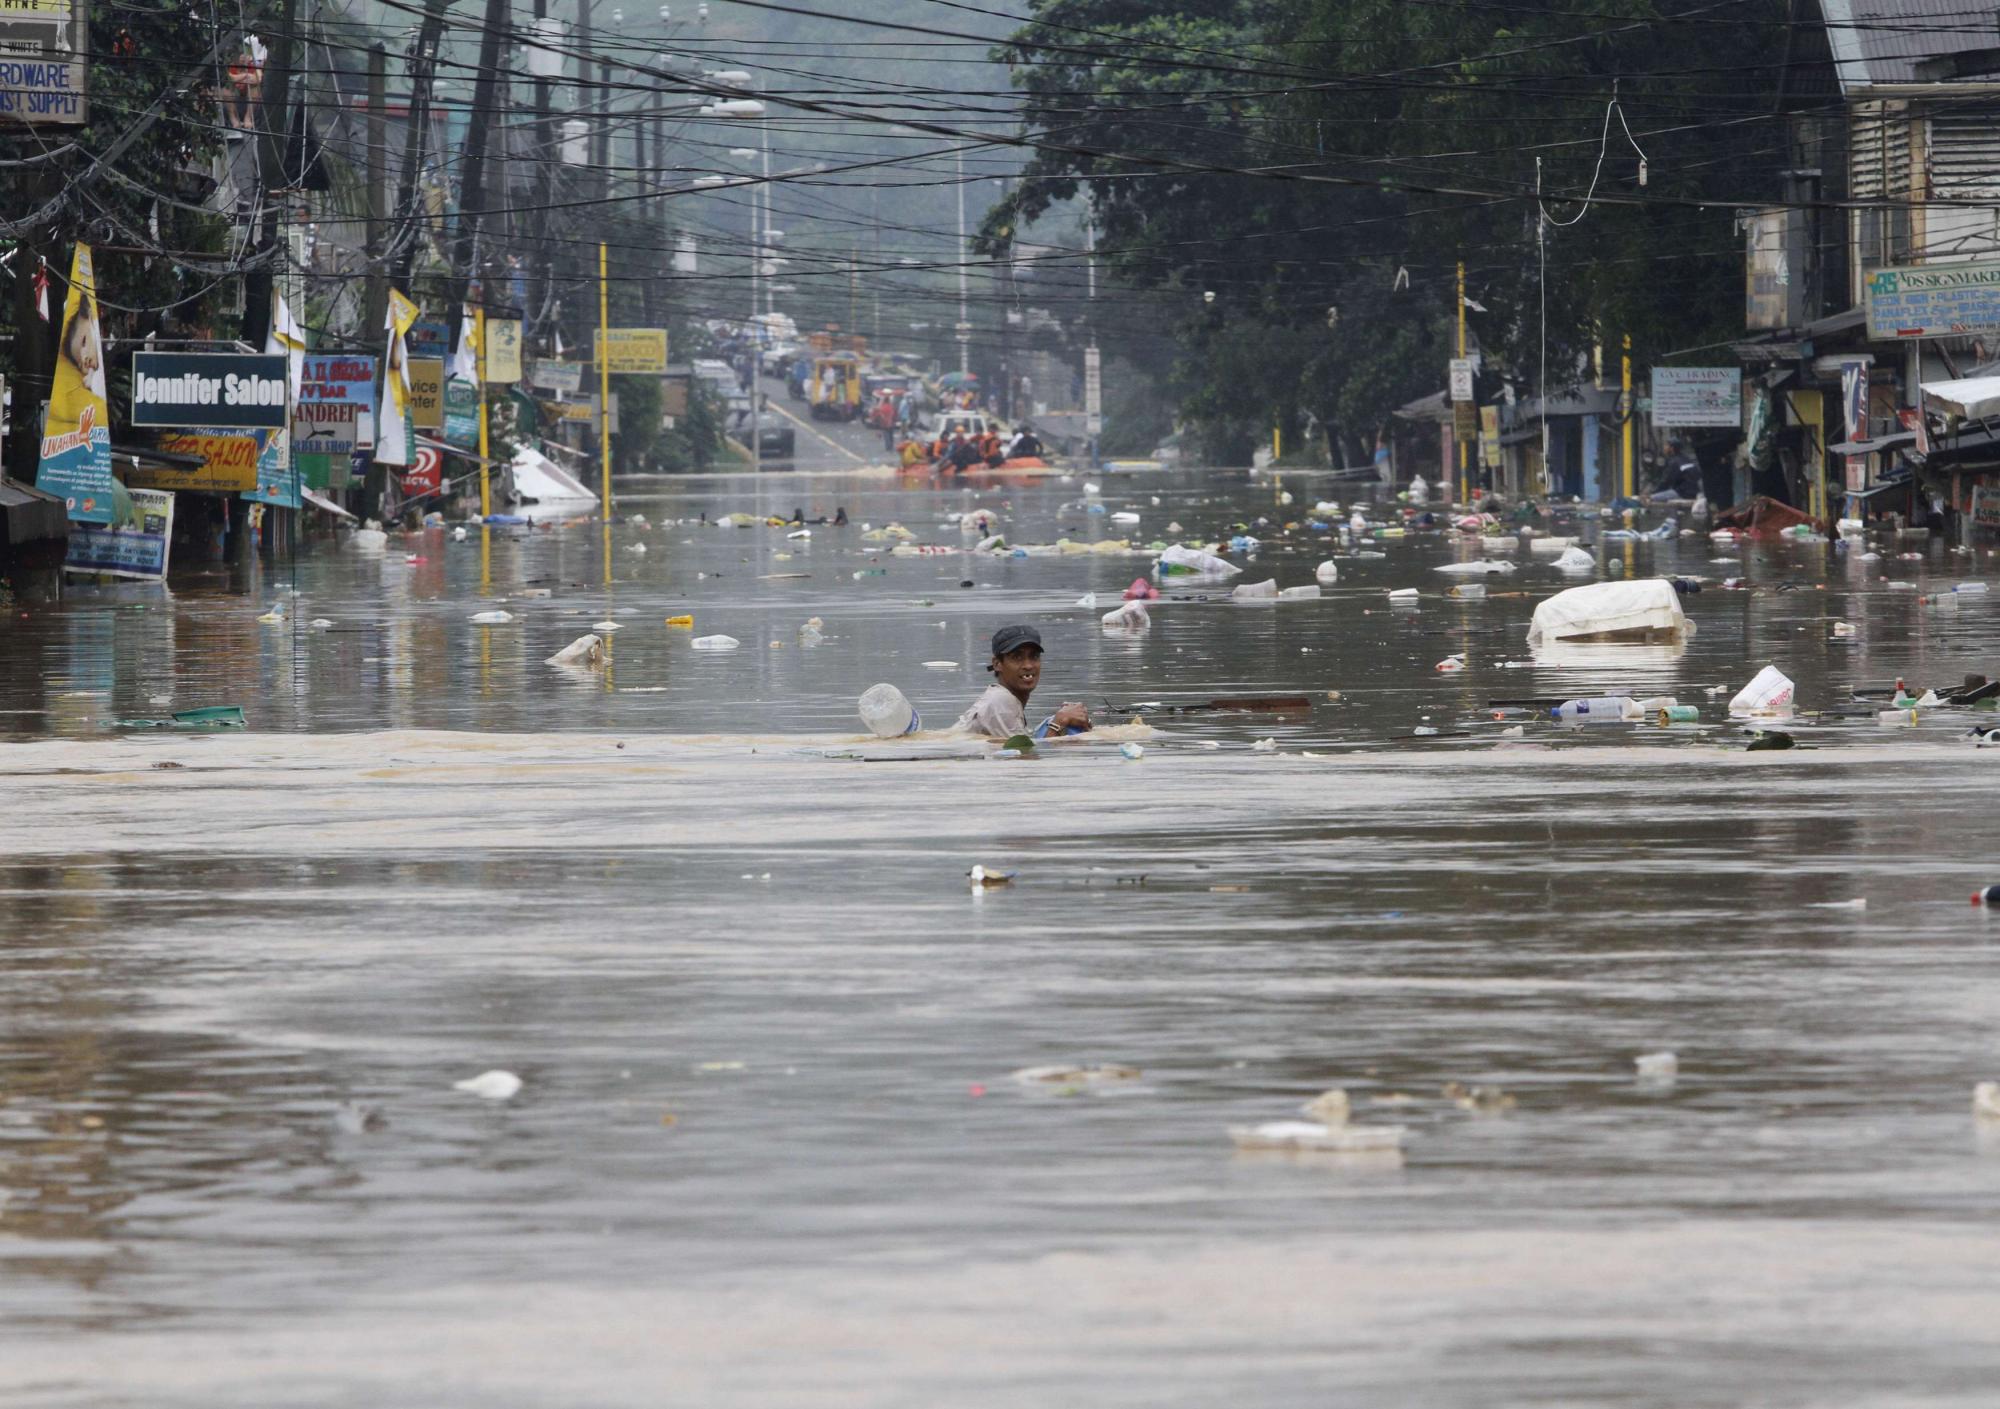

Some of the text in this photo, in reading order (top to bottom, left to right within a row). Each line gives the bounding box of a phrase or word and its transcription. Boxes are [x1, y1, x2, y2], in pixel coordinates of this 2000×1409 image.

[0, 0, 39, 9] RINE
[28, 91, 80, 115] SUPPLY
[135, 372, 285, 406] Jennifer Salon
[409, 380, 438, 394] vice
[410, 396, 437, 410] nter
[295, 404, 354, 423] ANDREI
[202, 438, 256, 468] SALON
[325, 441, 352, 453] SHOP
